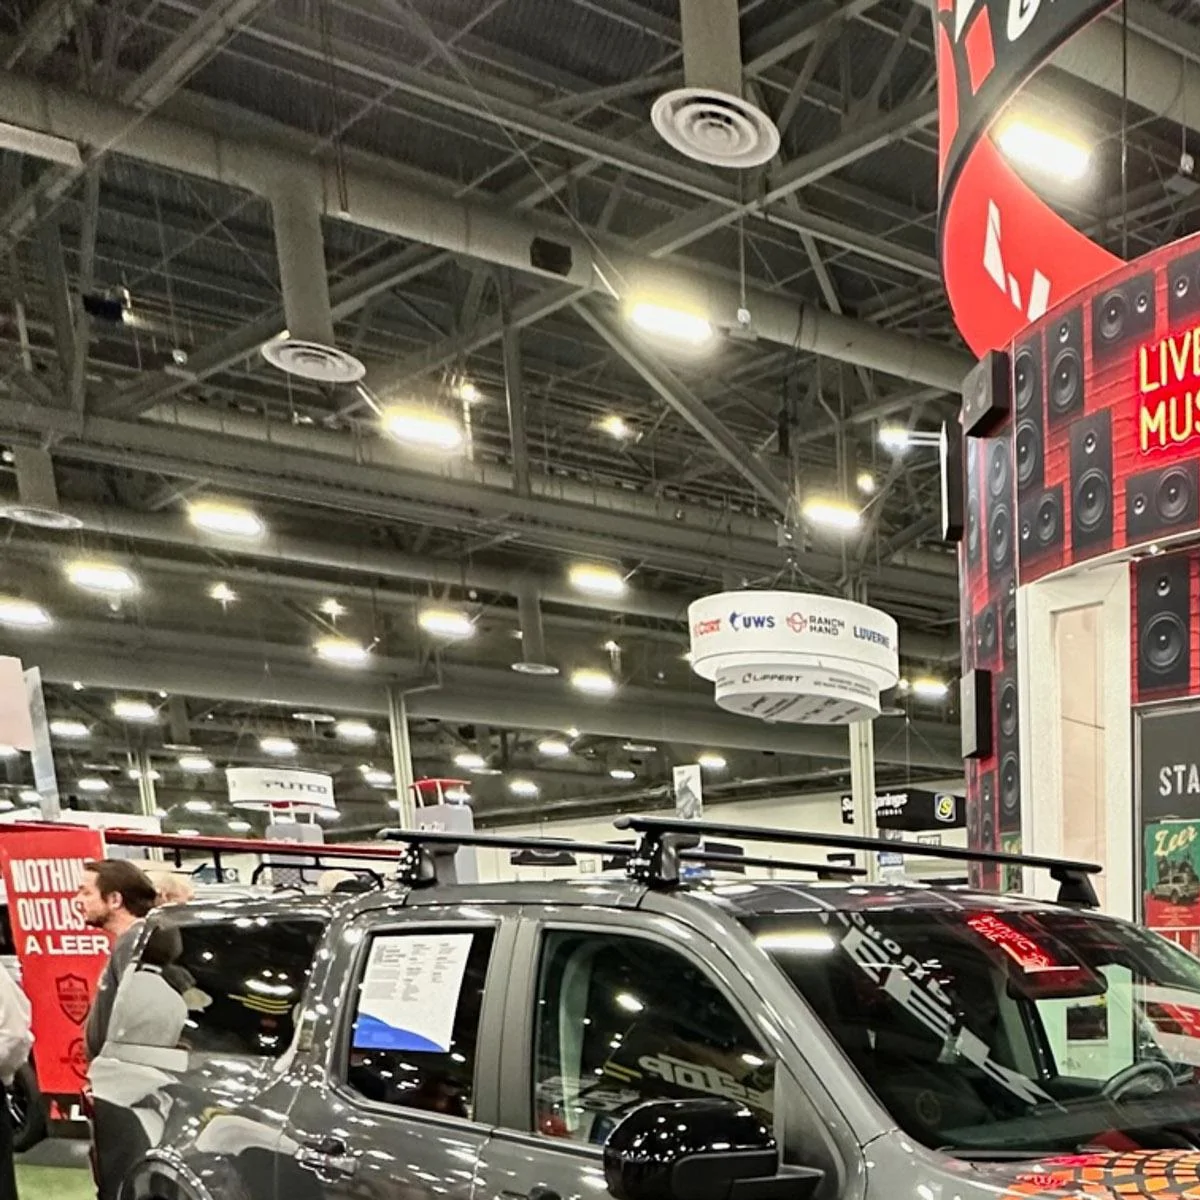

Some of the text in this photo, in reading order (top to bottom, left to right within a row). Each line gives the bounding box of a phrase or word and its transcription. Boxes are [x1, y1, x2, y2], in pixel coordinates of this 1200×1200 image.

[742, 616, 775, 629] UWS
[809, 615, 845, 629] RANCH
[809, 625, 839, 636] HAND
[1154, 824, 1198, 857] Leer
[10, 857, 96, 893] NOTHIN
[17, 897, 93, 931] OUTLAS
[25, 934, 111, 955] A LEER
